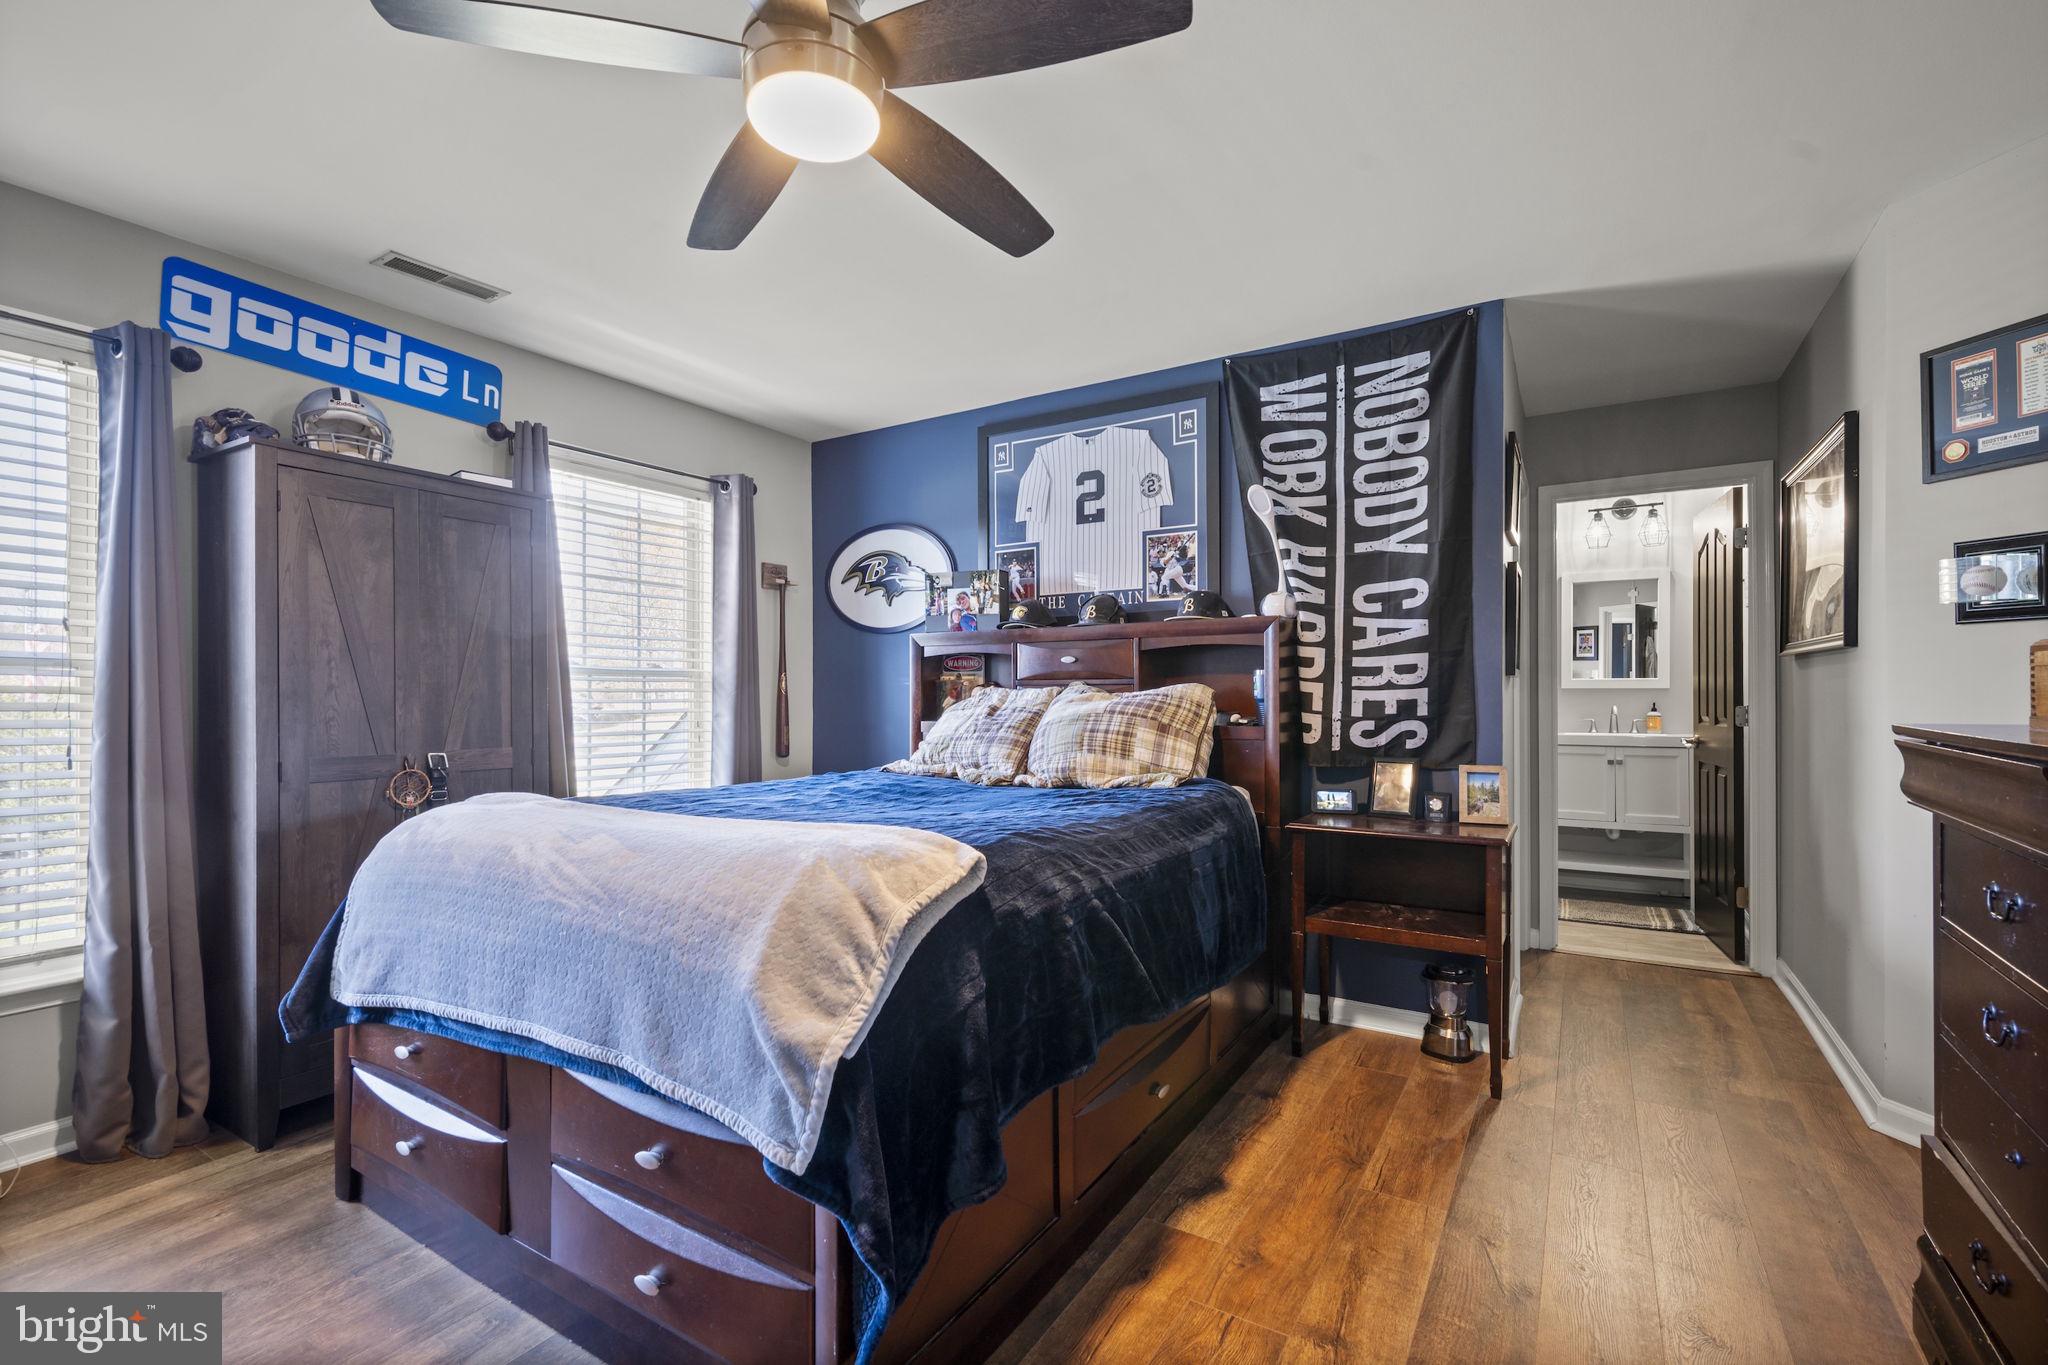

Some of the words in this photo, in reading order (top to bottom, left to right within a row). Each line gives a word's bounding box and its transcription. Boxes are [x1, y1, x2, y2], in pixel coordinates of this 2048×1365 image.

[166, 275, 449, 397] goode
[462, 370, 500, 410] Ln
[1960, 373, 1989, 384] WORLD
[1259, 372, 1328, 527] WORK
[1353, 350, 1432, 554] NOBODY
[1147, 479, 1156, 493] 2
[1076, 470, 1105, 525] 2
[1039, 595, 1066, 609] THE
[1078, 590, 1144, 607] CAIN
[1183, 598, 1195, 614] B
[1085, 605, 1097, 619] B
[948, 659, 979, 667] WARNING
[1348, 577, 1430, 750] CARES
